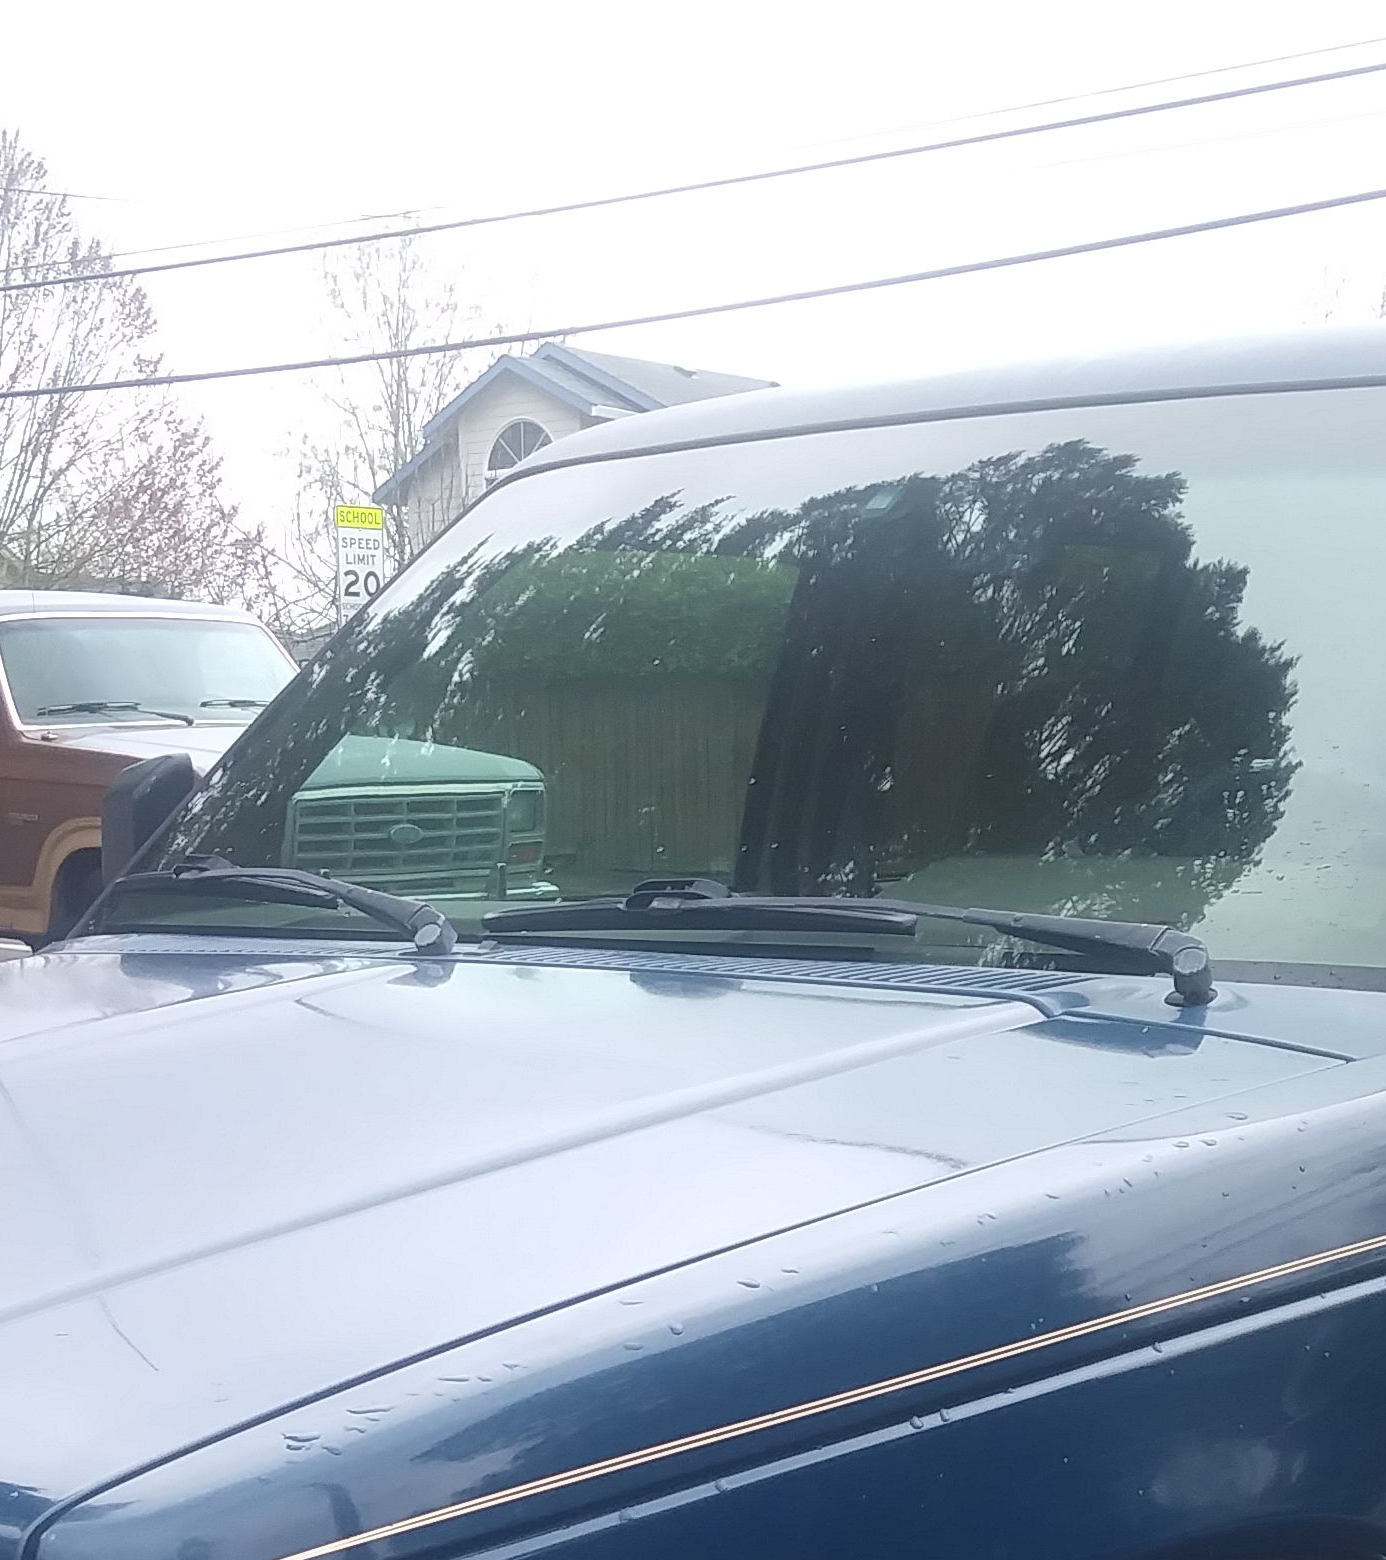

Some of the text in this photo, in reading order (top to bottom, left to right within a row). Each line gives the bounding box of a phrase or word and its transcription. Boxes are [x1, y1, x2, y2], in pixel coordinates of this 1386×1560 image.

[339, 510, 381, 525] SCHOOL
[341, 537, 380, 550] SPEED
[345, 554, 376, 566] LIMIT
[343, 569, 380, 597] 20
